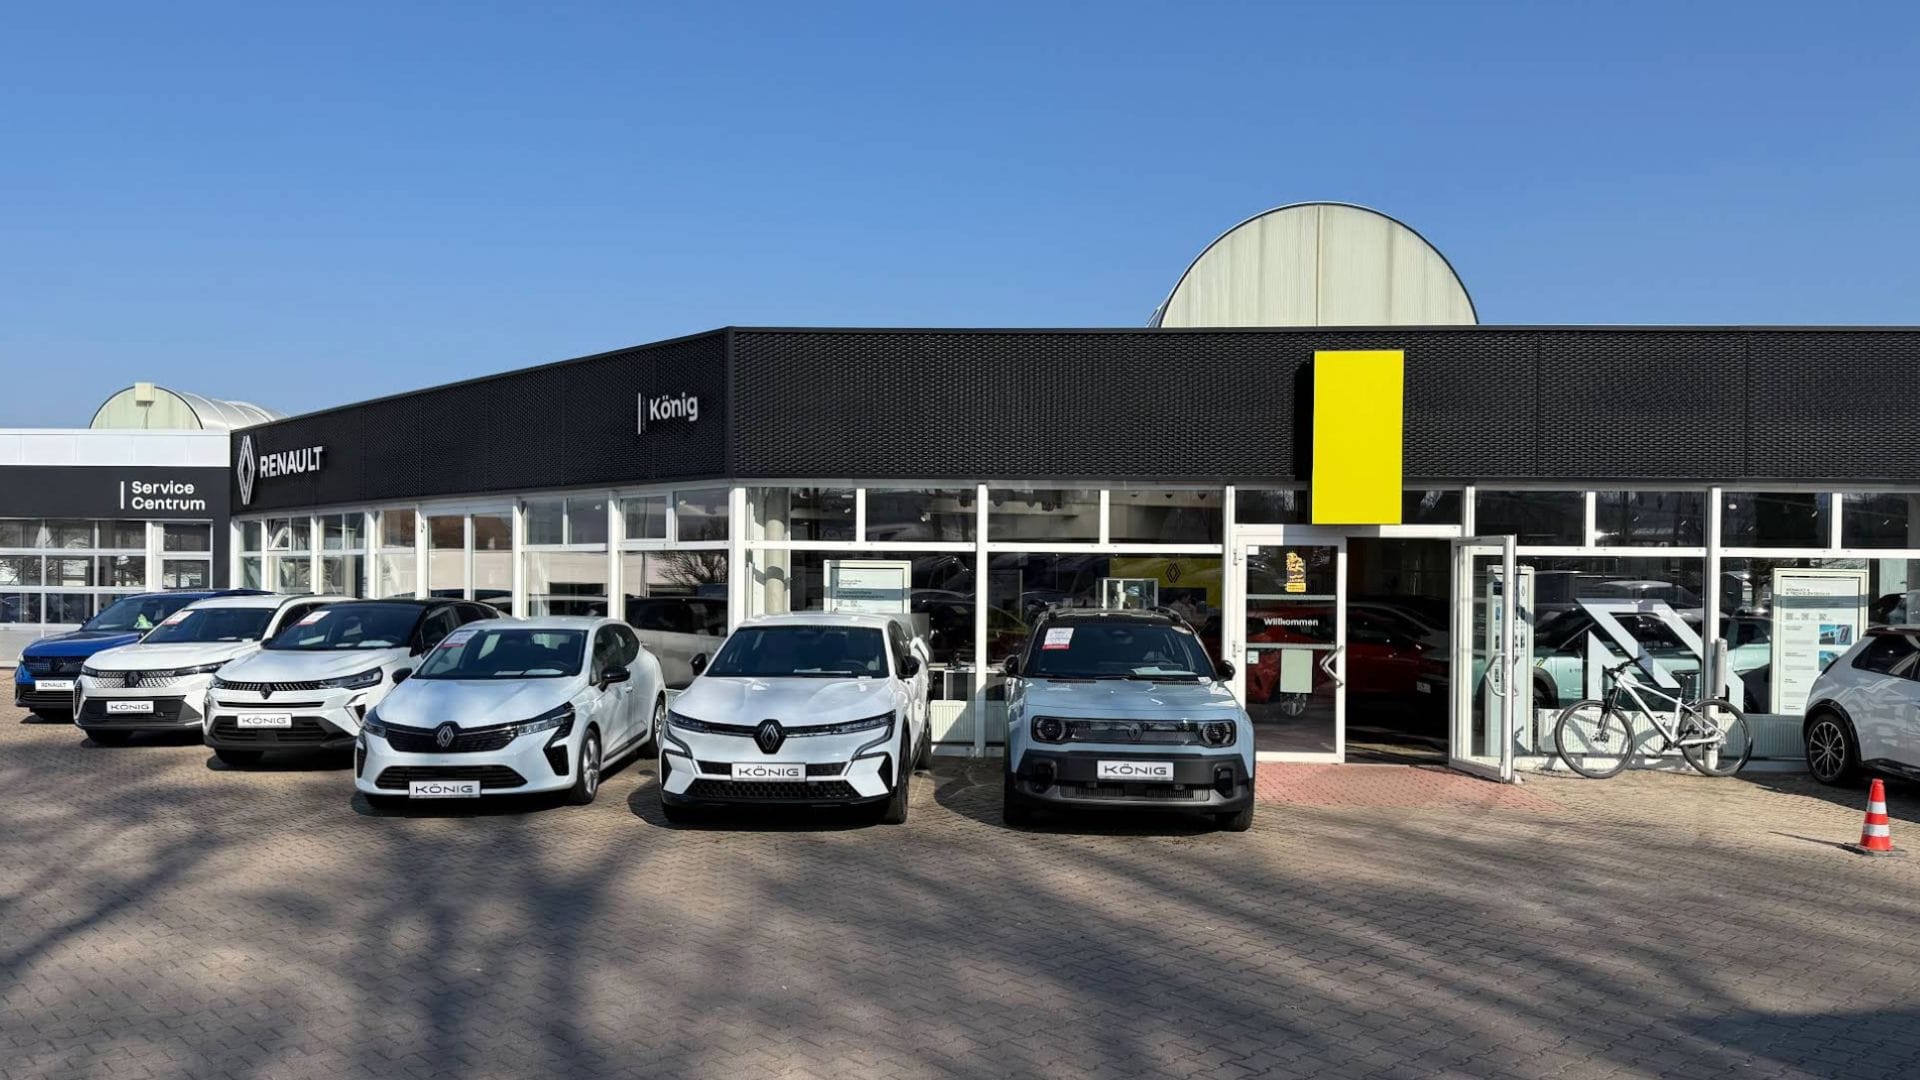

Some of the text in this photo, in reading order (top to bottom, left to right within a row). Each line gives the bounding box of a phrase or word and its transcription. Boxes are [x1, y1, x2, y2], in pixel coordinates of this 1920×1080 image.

[649, 391, 699, 422] König
[259, 446, 323, 478] RENAULT
[131, 480, 195, 495] Service
[131, 496, 206, 511] Centrum
[1263, 617, 1319, 627] Willkommen
[738, 765, 799, 777] KÖNIG
[1104, 763, 1167, 776] KÖNIG
[415, 783, 474, 794] KÖNIG
